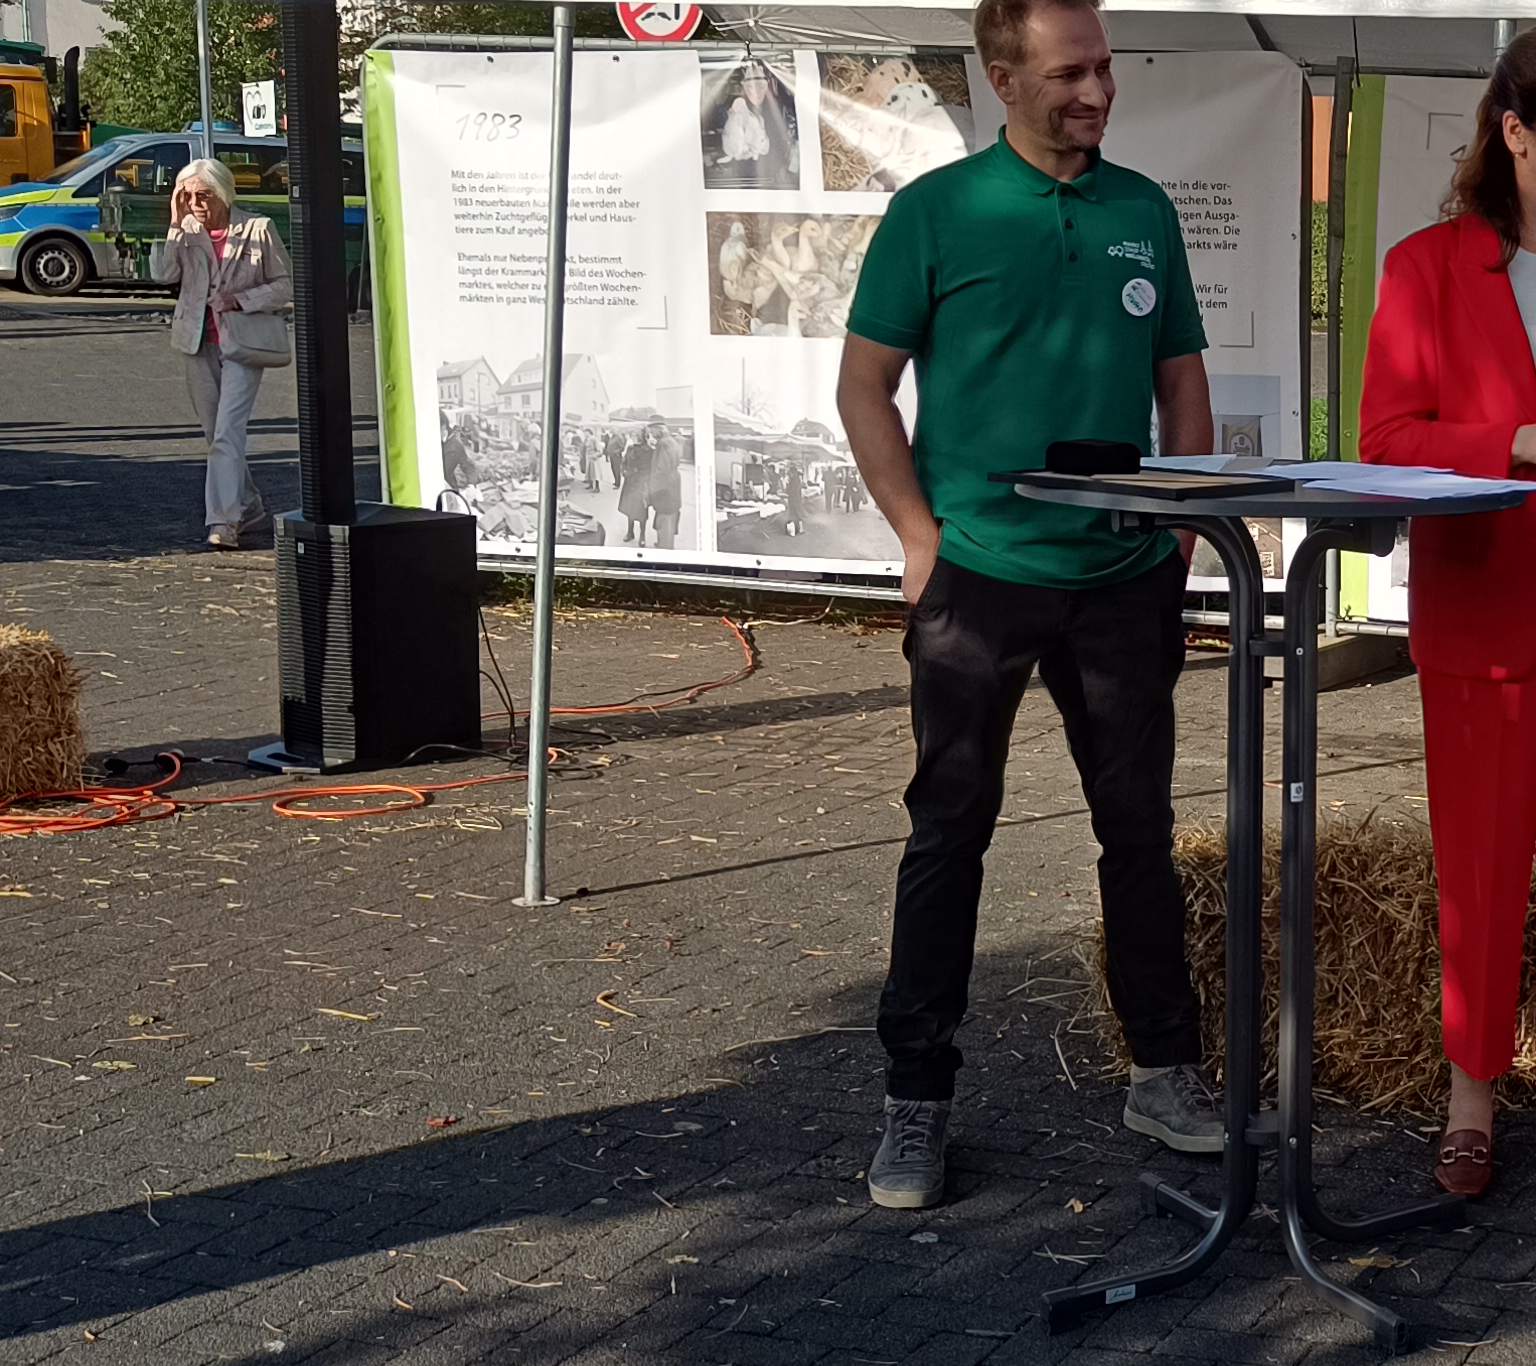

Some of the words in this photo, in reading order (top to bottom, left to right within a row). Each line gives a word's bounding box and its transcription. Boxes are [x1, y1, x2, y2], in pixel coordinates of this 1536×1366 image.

[455, 112, 522, 141] 1983
[452, 183, 467, 193] lich
[606, 185, 623, 195] der
[1210, 183, 1232, 191] vor-
[474, 197, 532, 208] neuerbauten
[582, 198, 618, 208] werden
[618, 199, 641, 209] aber
[1213, 195, 1233, 205] Das
[454, 211, 494, 221] weiterhin
[589, 213, 608, 223] und
[610, 213, 637, 223] Haus-
[1204, 210, 1240, 223] Ausga-
[454, 225, 475, 235] tiere
[474, 227, 494, 235] zum
[494, 225, 516, 235] Kauf
[1186, 225, 1221, 235] wären.
[1222, 225, 1241, 236] Die
[1213, 240, 1238, 250] wäre
[578, 254, 623, 264] bestimmt
[458, 265, 484, 278] längst
[484, 265, 501, 276] der
[588, 267, 605, 278] des
[604, 268, 647, 278] Wochen-
[496, 280, 531, 290] welcher
[600, 282, 642, 292] Wochen-
[459, 293, 496, 304] märkten
[506, 296, 528, 306] ganz
[606, 296, 639, 306] zählte.
[1204, 298, 1228, 309] dem
